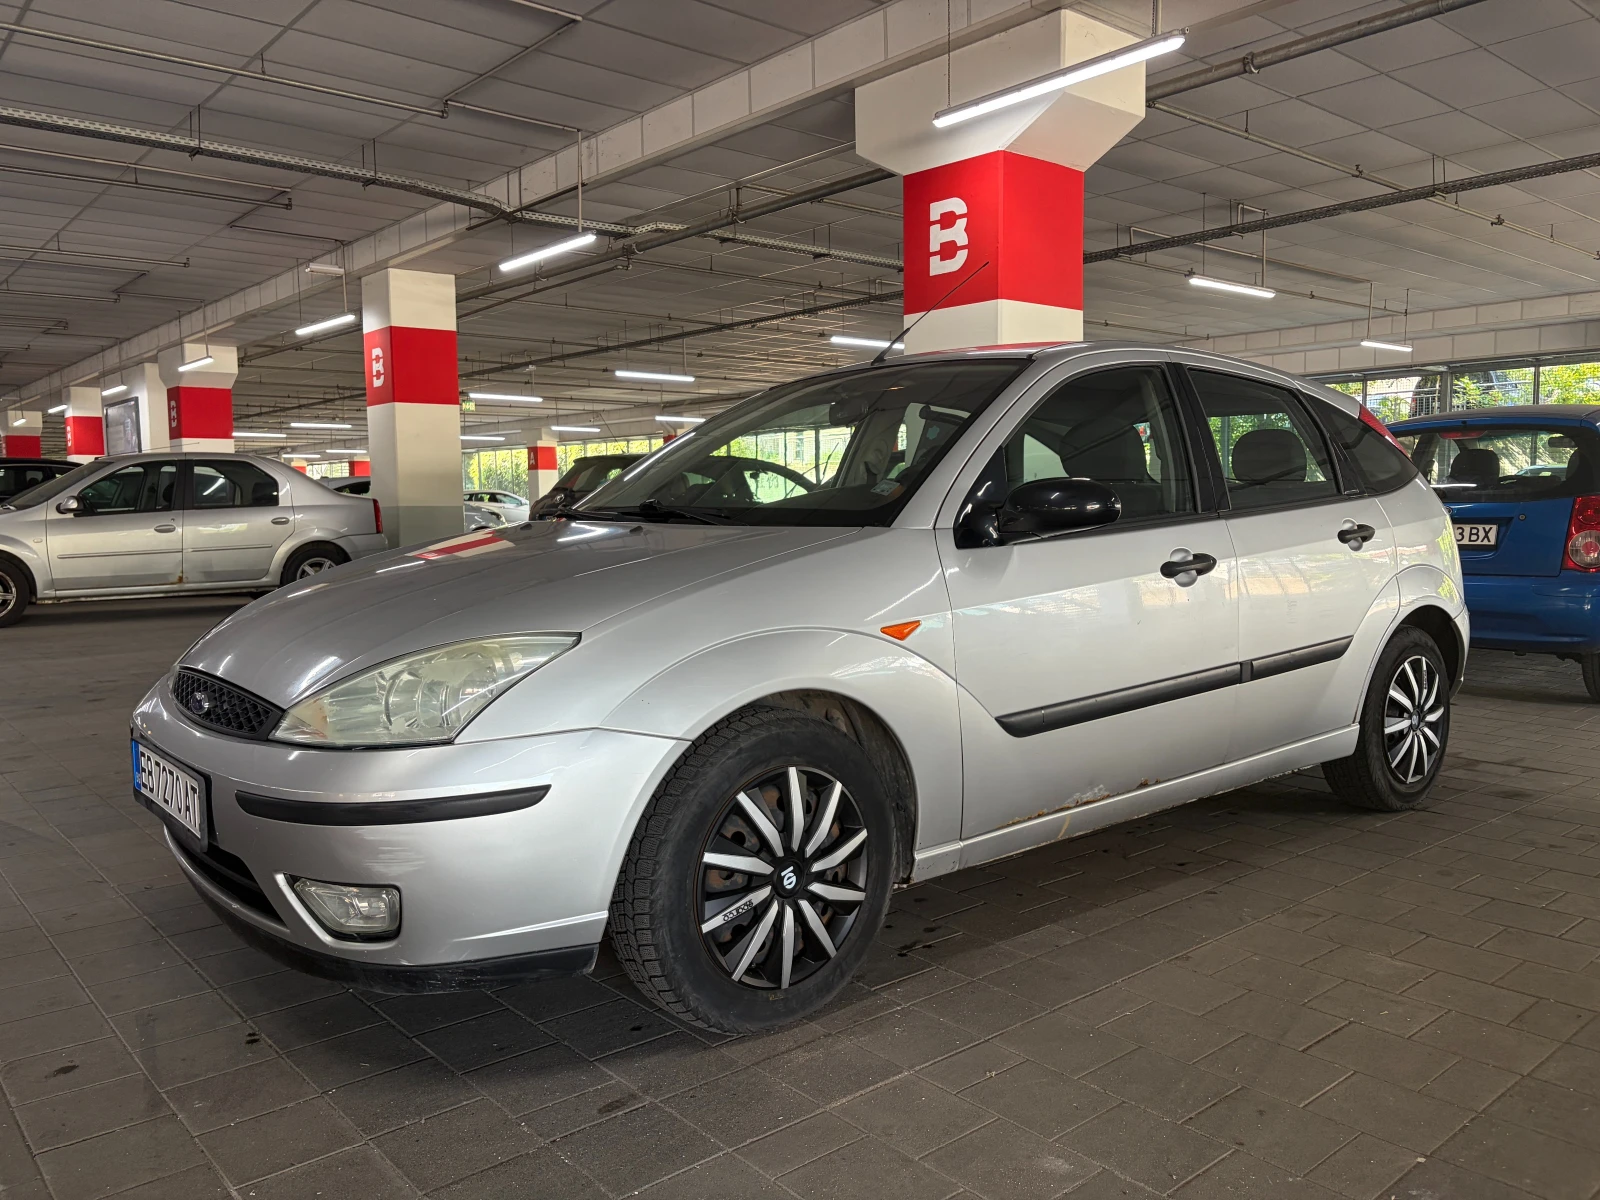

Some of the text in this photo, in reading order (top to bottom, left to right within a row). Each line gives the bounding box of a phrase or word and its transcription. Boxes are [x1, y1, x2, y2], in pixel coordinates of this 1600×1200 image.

[929, 196, 969, 277] B
[371, 346, 385, 388] B
[1468, 526, 1493, 543] BX
[185, 780, 199, 829] AT
